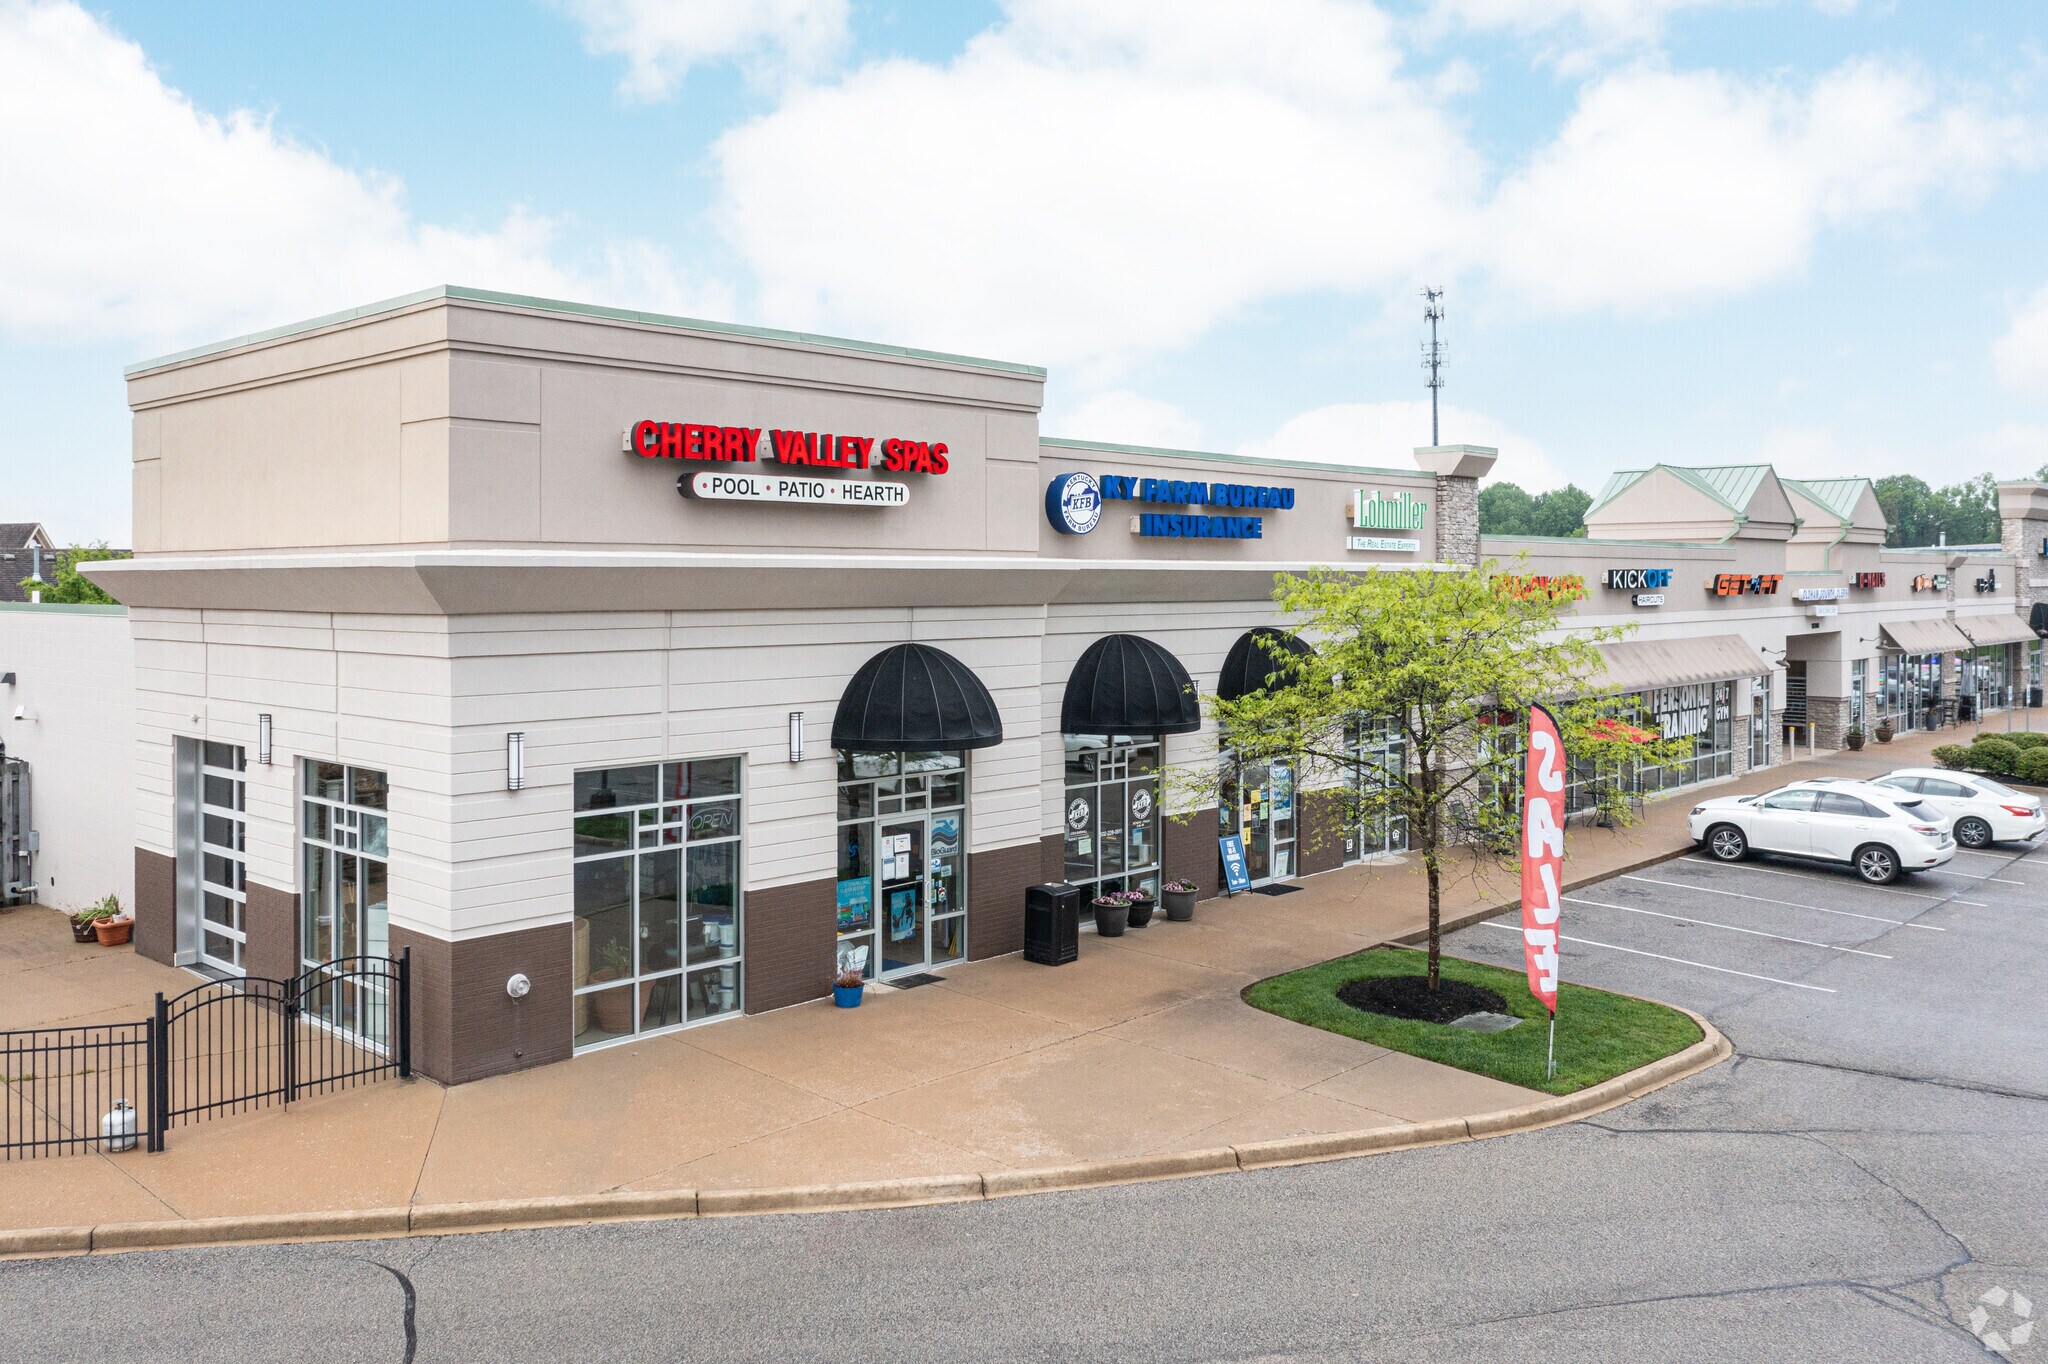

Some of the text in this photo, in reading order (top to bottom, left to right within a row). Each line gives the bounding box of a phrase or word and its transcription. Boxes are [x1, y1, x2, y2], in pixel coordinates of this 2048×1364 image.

[634, 419, 949, 475] CHERRY VALLEY SPAS
[712, 478, 904, 503] POOL PATIO HEARTH
[1066, 474, 1096, 489] KENTUCKY
[1103, 475, 1295, 510] KY FARM BUREAU
[1072, 497, 1092, 510] KFB
[1359, 489, 1427, 530] Lohmiller
[1078, 512, 1099, 532] BUREAU
[1145, 514, 1263, 539] INSURANCE
[1717, 574, 1752, 595] GET
[1653, 683, 1710, 714] PERSONAL
[1716, 705, 1730, 721] GYM
[690, 811, 733, 831] OPEN
[930, 845, 958, 856] BioGuard
